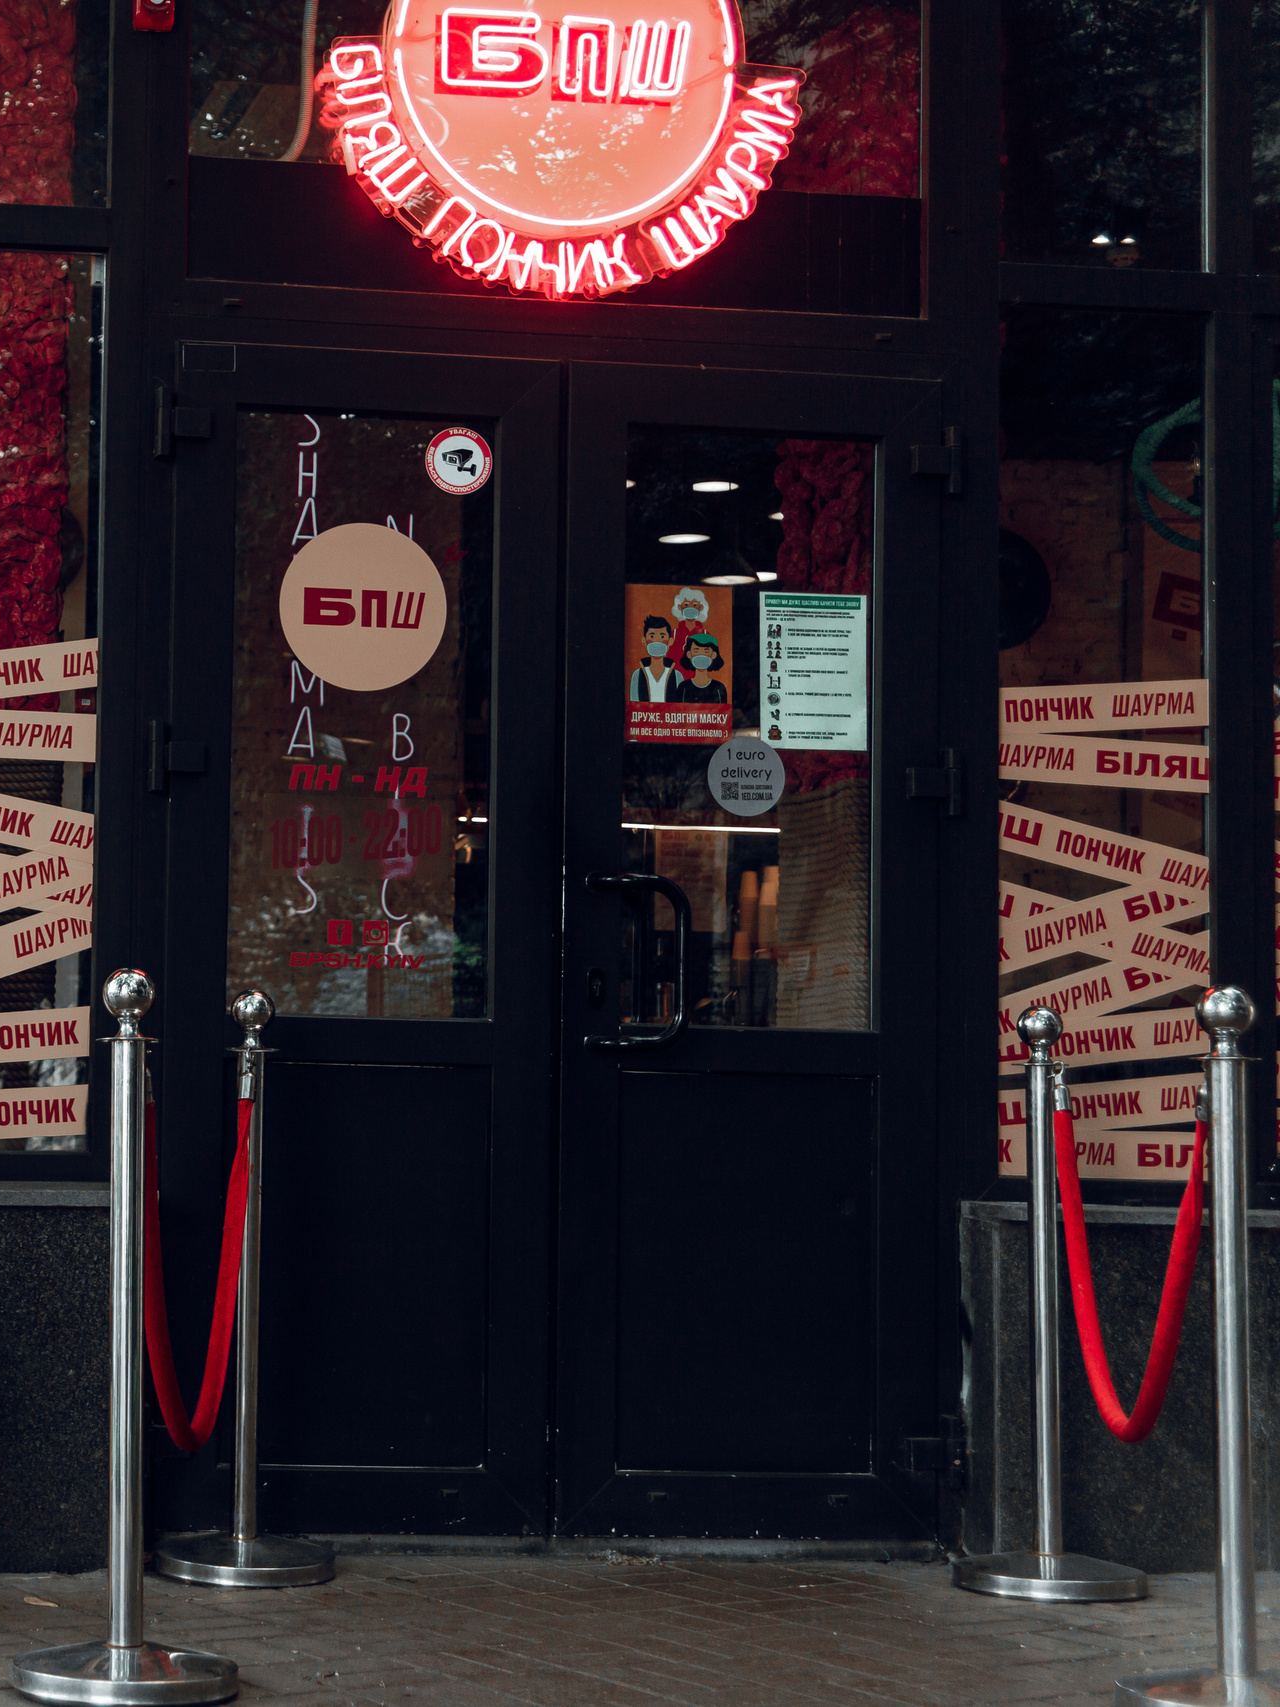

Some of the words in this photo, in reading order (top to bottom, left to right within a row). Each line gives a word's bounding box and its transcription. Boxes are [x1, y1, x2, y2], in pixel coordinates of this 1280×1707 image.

[434, 7, 692, 107] БПШ
[424, 196, 642, 292] ПОНЧИК
[650, 77, 798, 268] ШАУРМА
[303, 586, 426, 630] БПШ
[631, 711, 663, 723] ДРУЖЕ,
[665, 712, 698, 724] ВДЯГНИ
[699, 713, 728, 724] МАСКУ
[1005, 696, 1094, 723] ПОНЧИК
[1111, 691, 1195, 718] ШАУРМА
[630, 727, 640, 735] МИ
[641, 728, 652, 736] ВСЕ
[653, 728, 670, 737] ОДНО
[672, 728, 686, 737] ТЕБЕ
[727, 748, 731, 760] 1
[736, 751, 765, 760] euro
[288, 764, 342, 790] ПН
[374, 766, 428, 798] НД
[721, 766, 773, 781] delivery
[50, 819, 93, 850] ШАУ
[269, 814, 343, 869] 10:00
[363, 804, 442, 861] 22:00
[1056, 829, 1145, 875] ПОНЧИК
[1160, 858, 1209, 891] ШАУ
[13, 917, 92, 958] ШАУРМ
[1025, 907, 1107, 953] ШАУРМА
[289, 952, 425, 968] BPSH.KYIV
[1153, 1018, 1206, 1046] ШАУ
[1070, 1090, 1143, 1120] ОНЧИК
[1161, 1085, 1202, 1111] ШАУ
[1074, 1142, 1115, 1165] РМА
[1137, 1143, 1195, 1169] БІЛ
